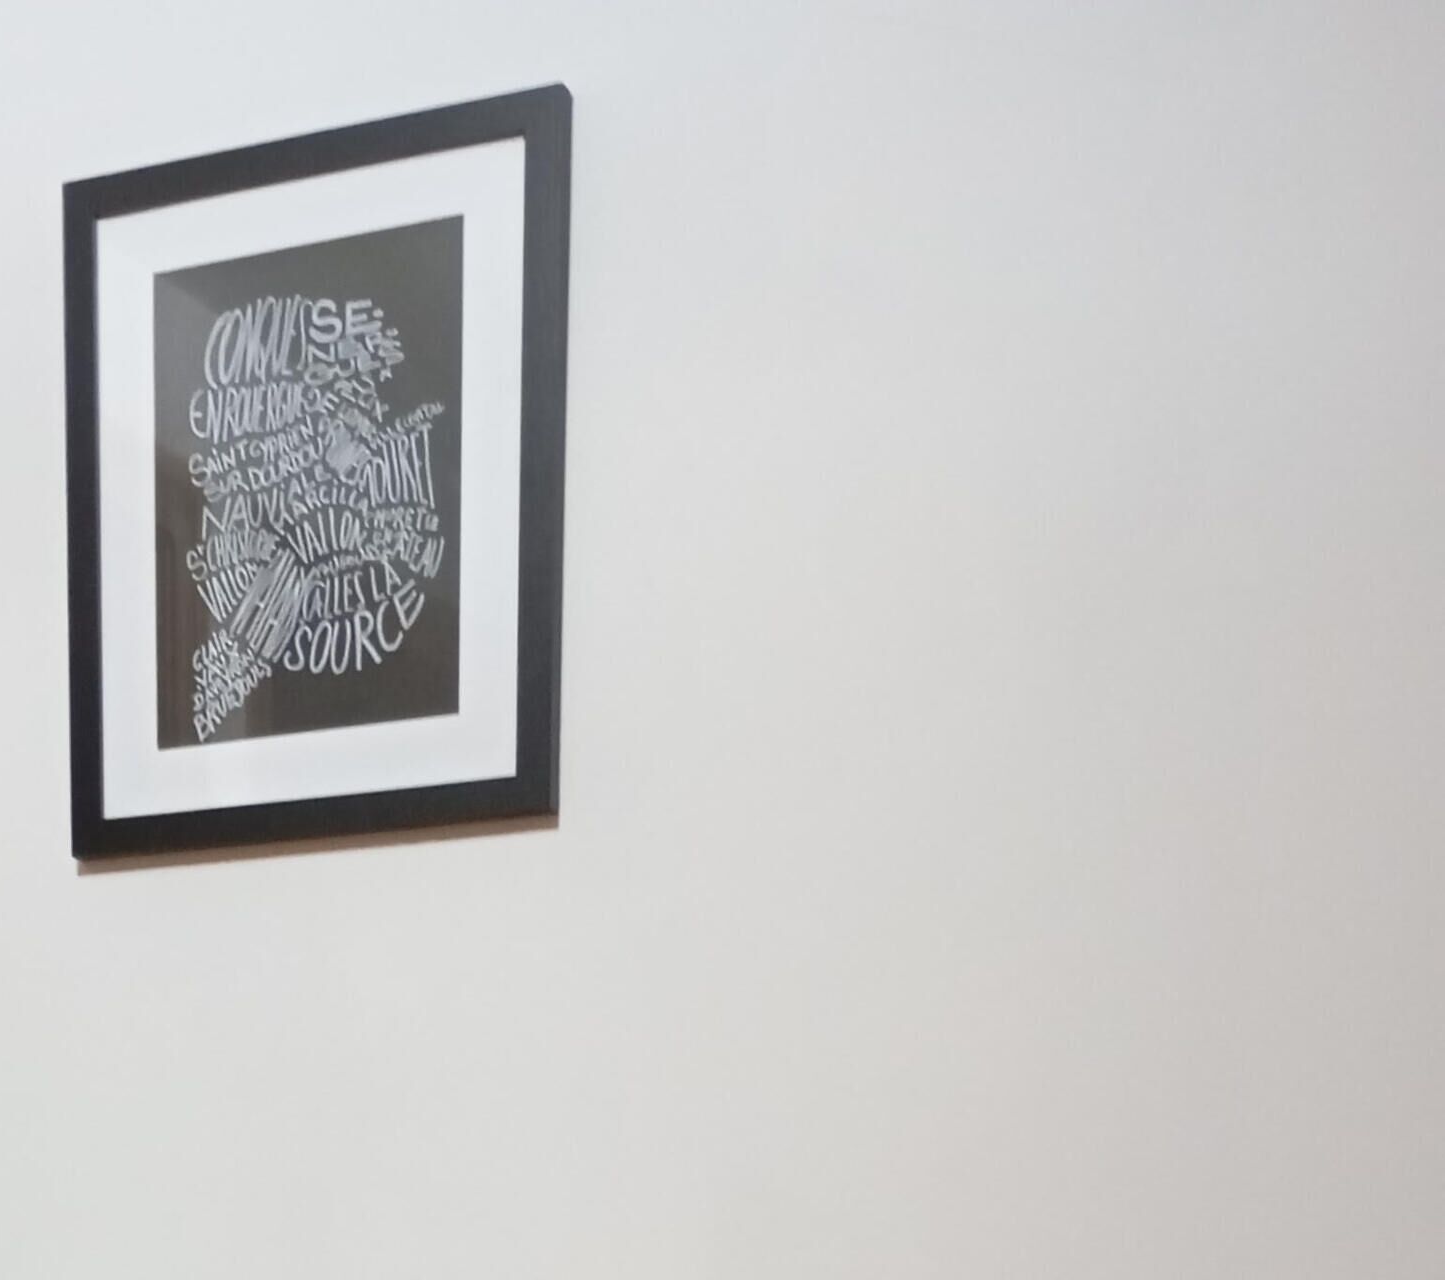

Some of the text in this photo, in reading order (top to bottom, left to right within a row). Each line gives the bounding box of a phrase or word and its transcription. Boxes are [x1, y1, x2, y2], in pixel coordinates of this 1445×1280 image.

[204, 294, 309, 390] CONQUES
[189, 438, 248, 487] SAINT
[283, 578, 426, 675] SOURCE
